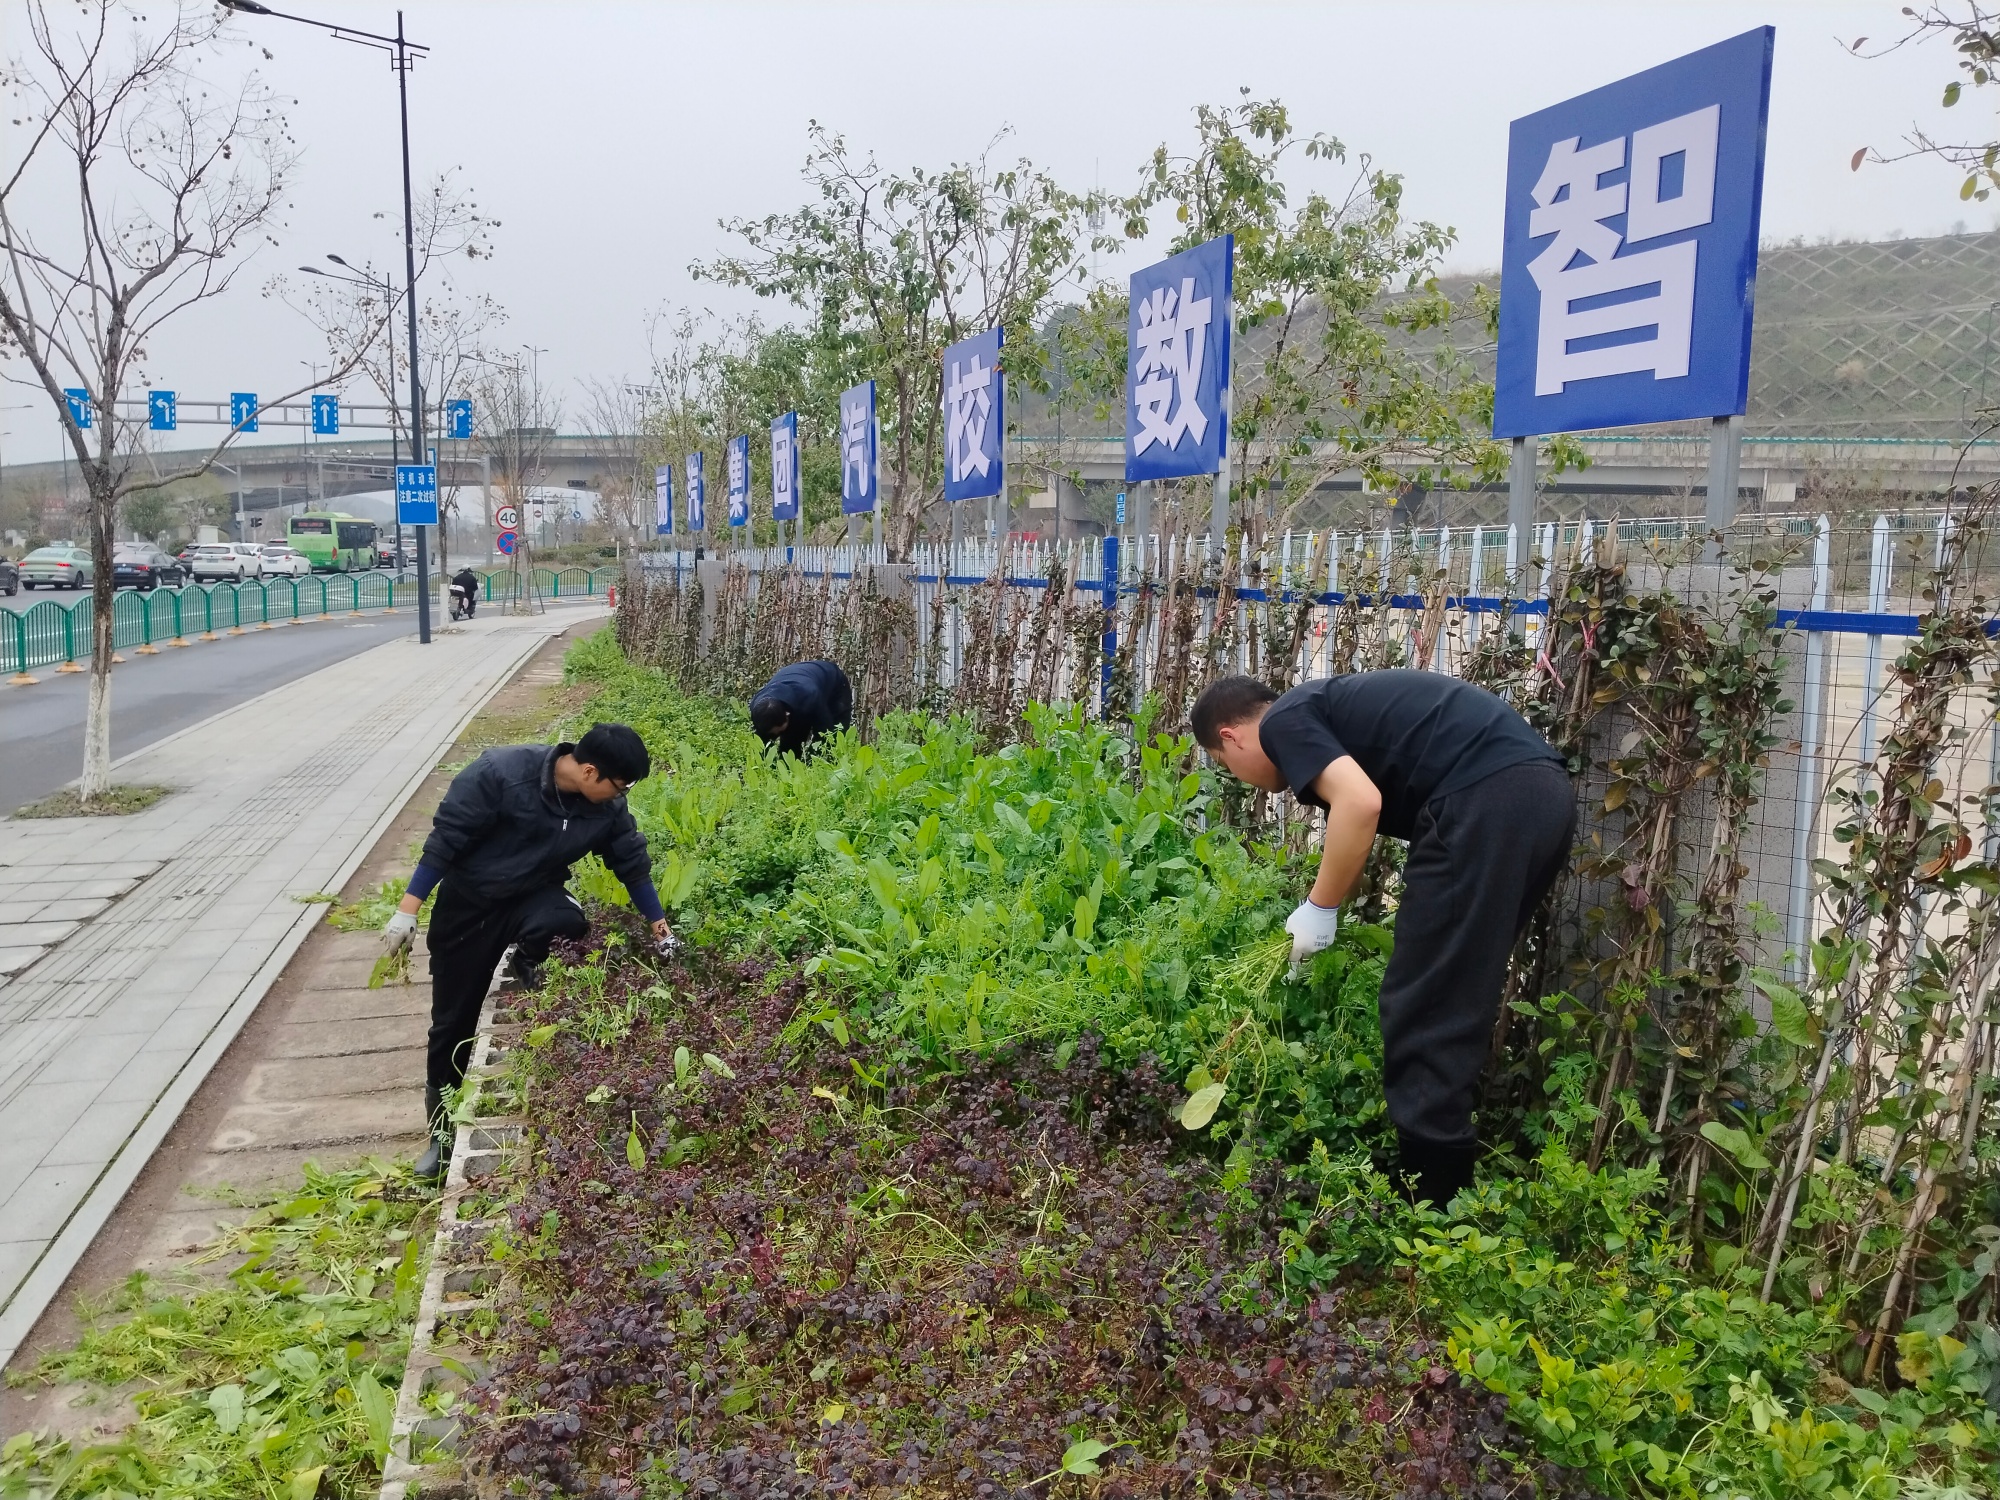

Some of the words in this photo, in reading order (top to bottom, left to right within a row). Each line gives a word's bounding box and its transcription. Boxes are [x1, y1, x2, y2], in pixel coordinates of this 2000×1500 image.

[1526, 104, 1721, 397] 智
[1134, 277, 1212, 457] 数
[841, 402, 869, 501] 汽
[947, 354, 993, 483] 校
[398, 472, 435, 485] 非机动车
[399, 490, 435, 503] 注意二次过街
[686, 463, 700, 522] 汽
[729, 446, 744, 518] 集
[772, 426, 793, 508] 团
[500, 512, 517, 524] 40
